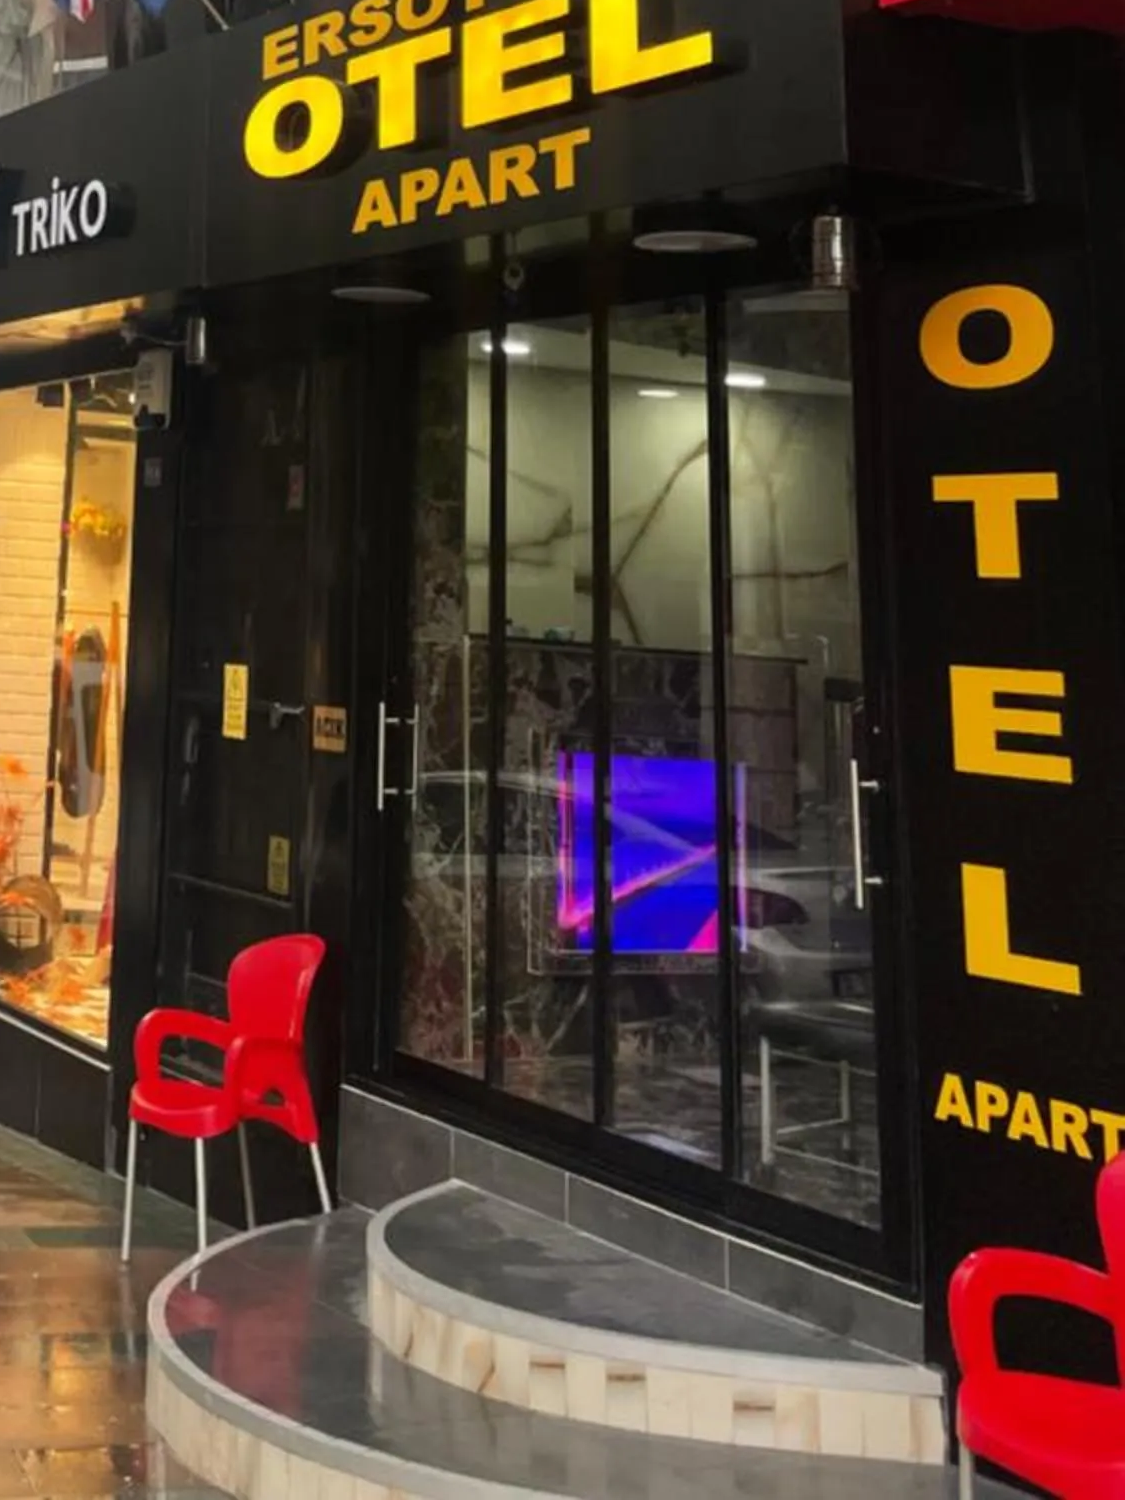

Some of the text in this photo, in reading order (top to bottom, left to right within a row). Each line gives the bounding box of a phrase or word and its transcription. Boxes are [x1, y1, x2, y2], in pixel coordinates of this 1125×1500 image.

[11, 176, 108, 257] TRİKO
[351, 127, 591, 234] APART
[918, 283, 1082, 996] OTEL
[933, 1071, 1125, 1165] APART
